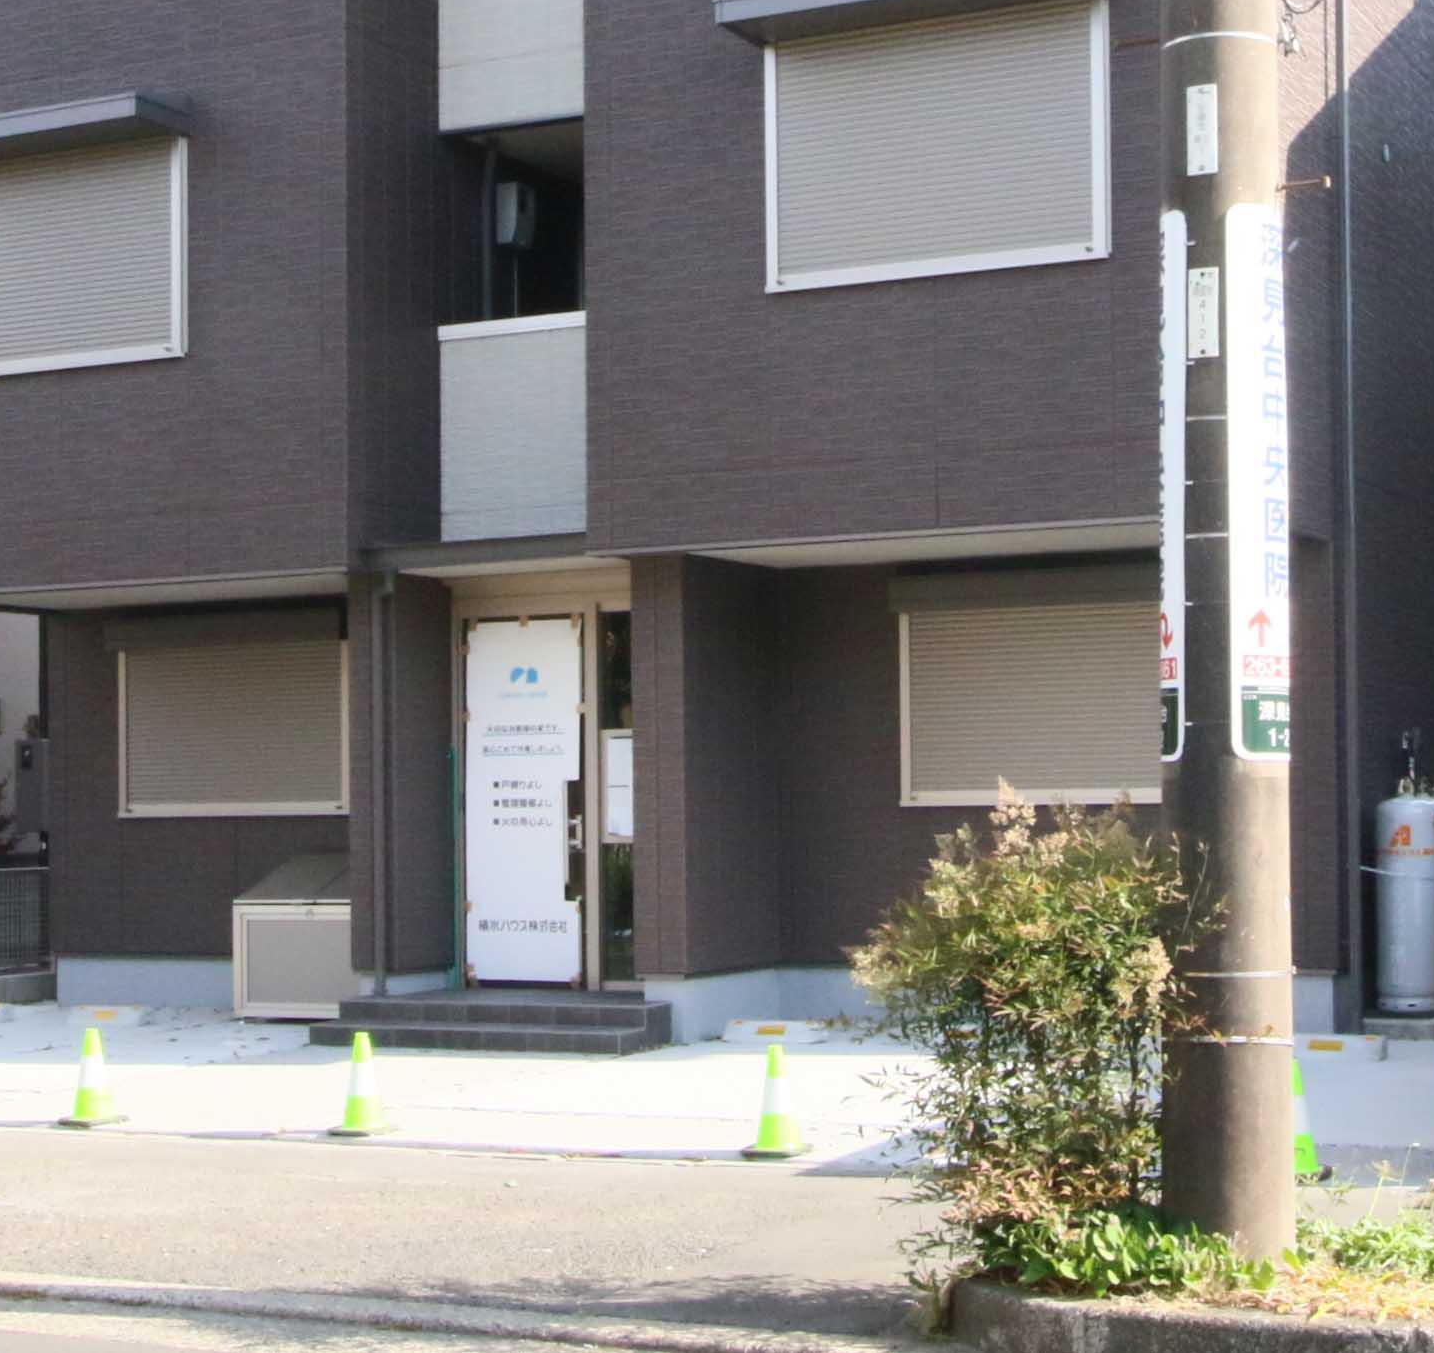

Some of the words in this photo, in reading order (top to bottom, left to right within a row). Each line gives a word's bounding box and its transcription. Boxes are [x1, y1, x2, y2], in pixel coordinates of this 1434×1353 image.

[478, 919, 567, 934] 積水ハウス株式会社
